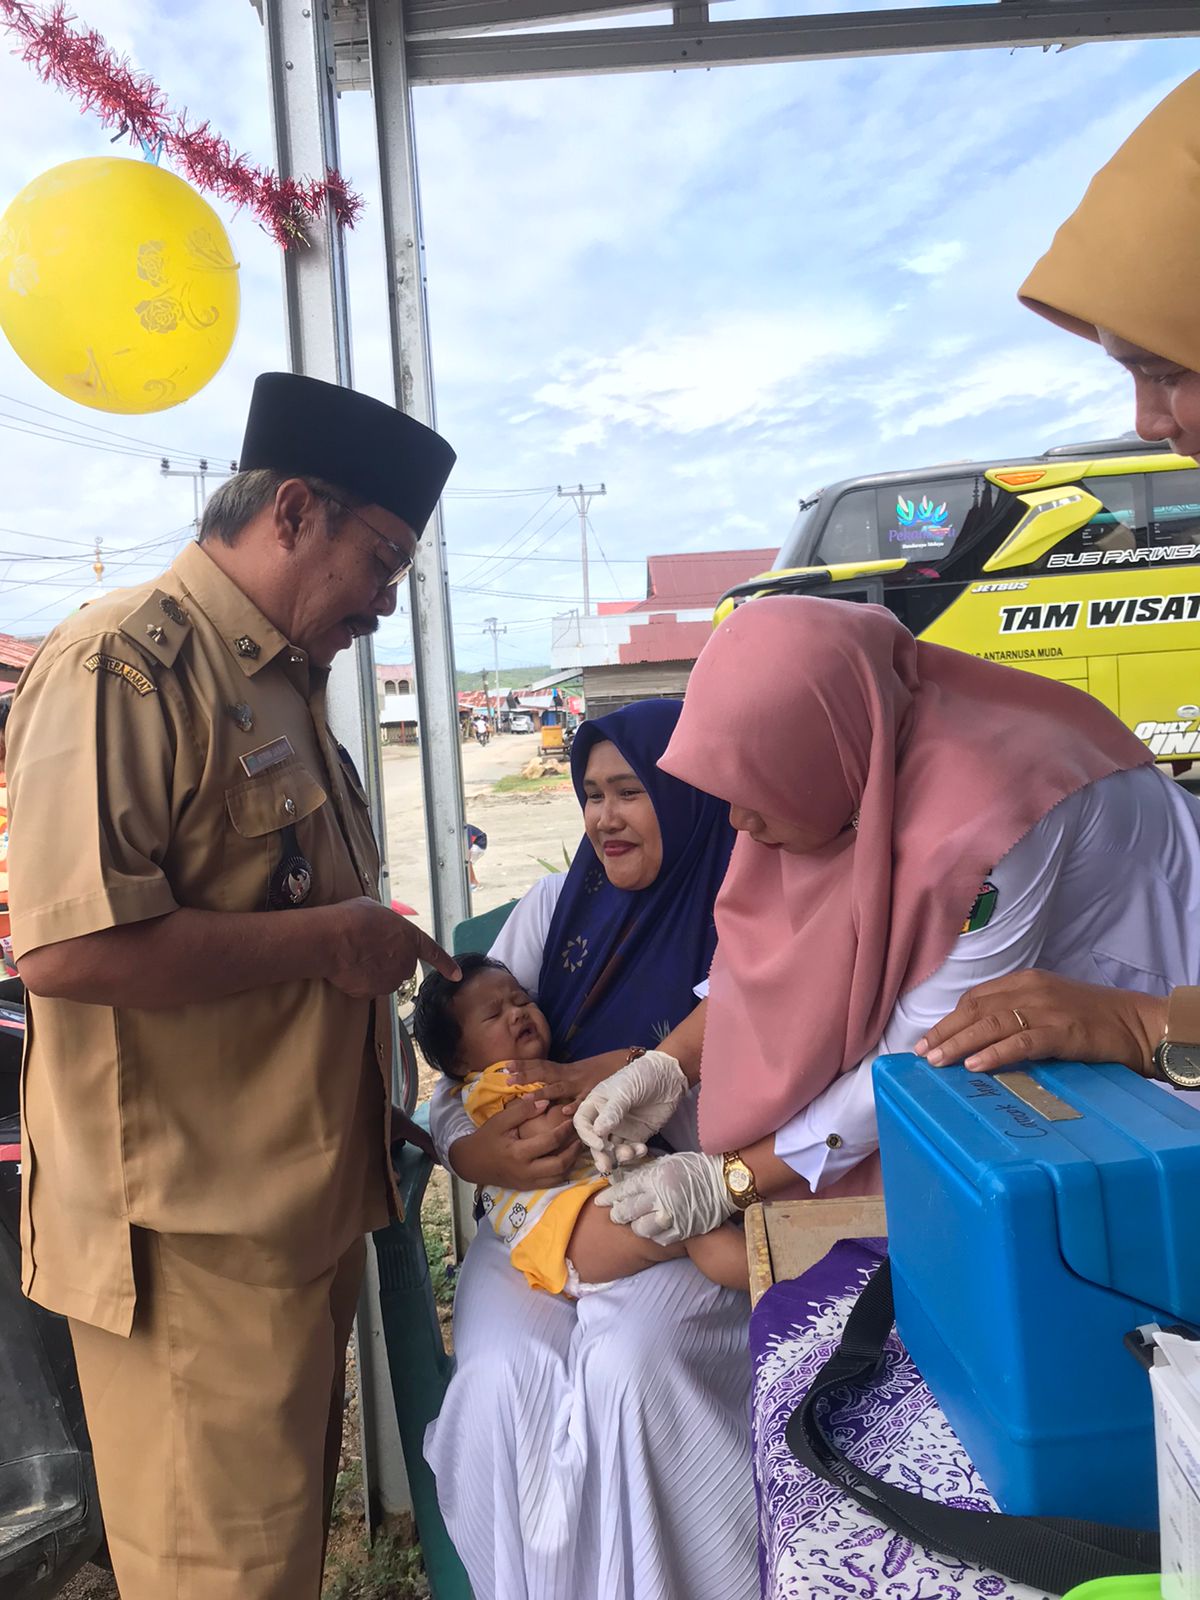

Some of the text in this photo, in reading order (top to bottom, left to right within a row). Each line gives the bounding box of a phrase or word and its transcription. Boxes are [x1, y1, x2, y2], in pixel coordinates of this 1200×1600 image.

[888, 527, 956, 542] Pekanu
[1047, 551, 1102, 568] BUS
[971, 582, 1029, 593] JETBUS
[1000, 594, 1200, 633] TAM WISAT
[984, 649, 1036, 660] ANTARNUSA
[1037, 647, 1064, 658] MUDA
[126, 669, 151, 691] BARAT
[1134, 721, 1193, 740] ONLY
